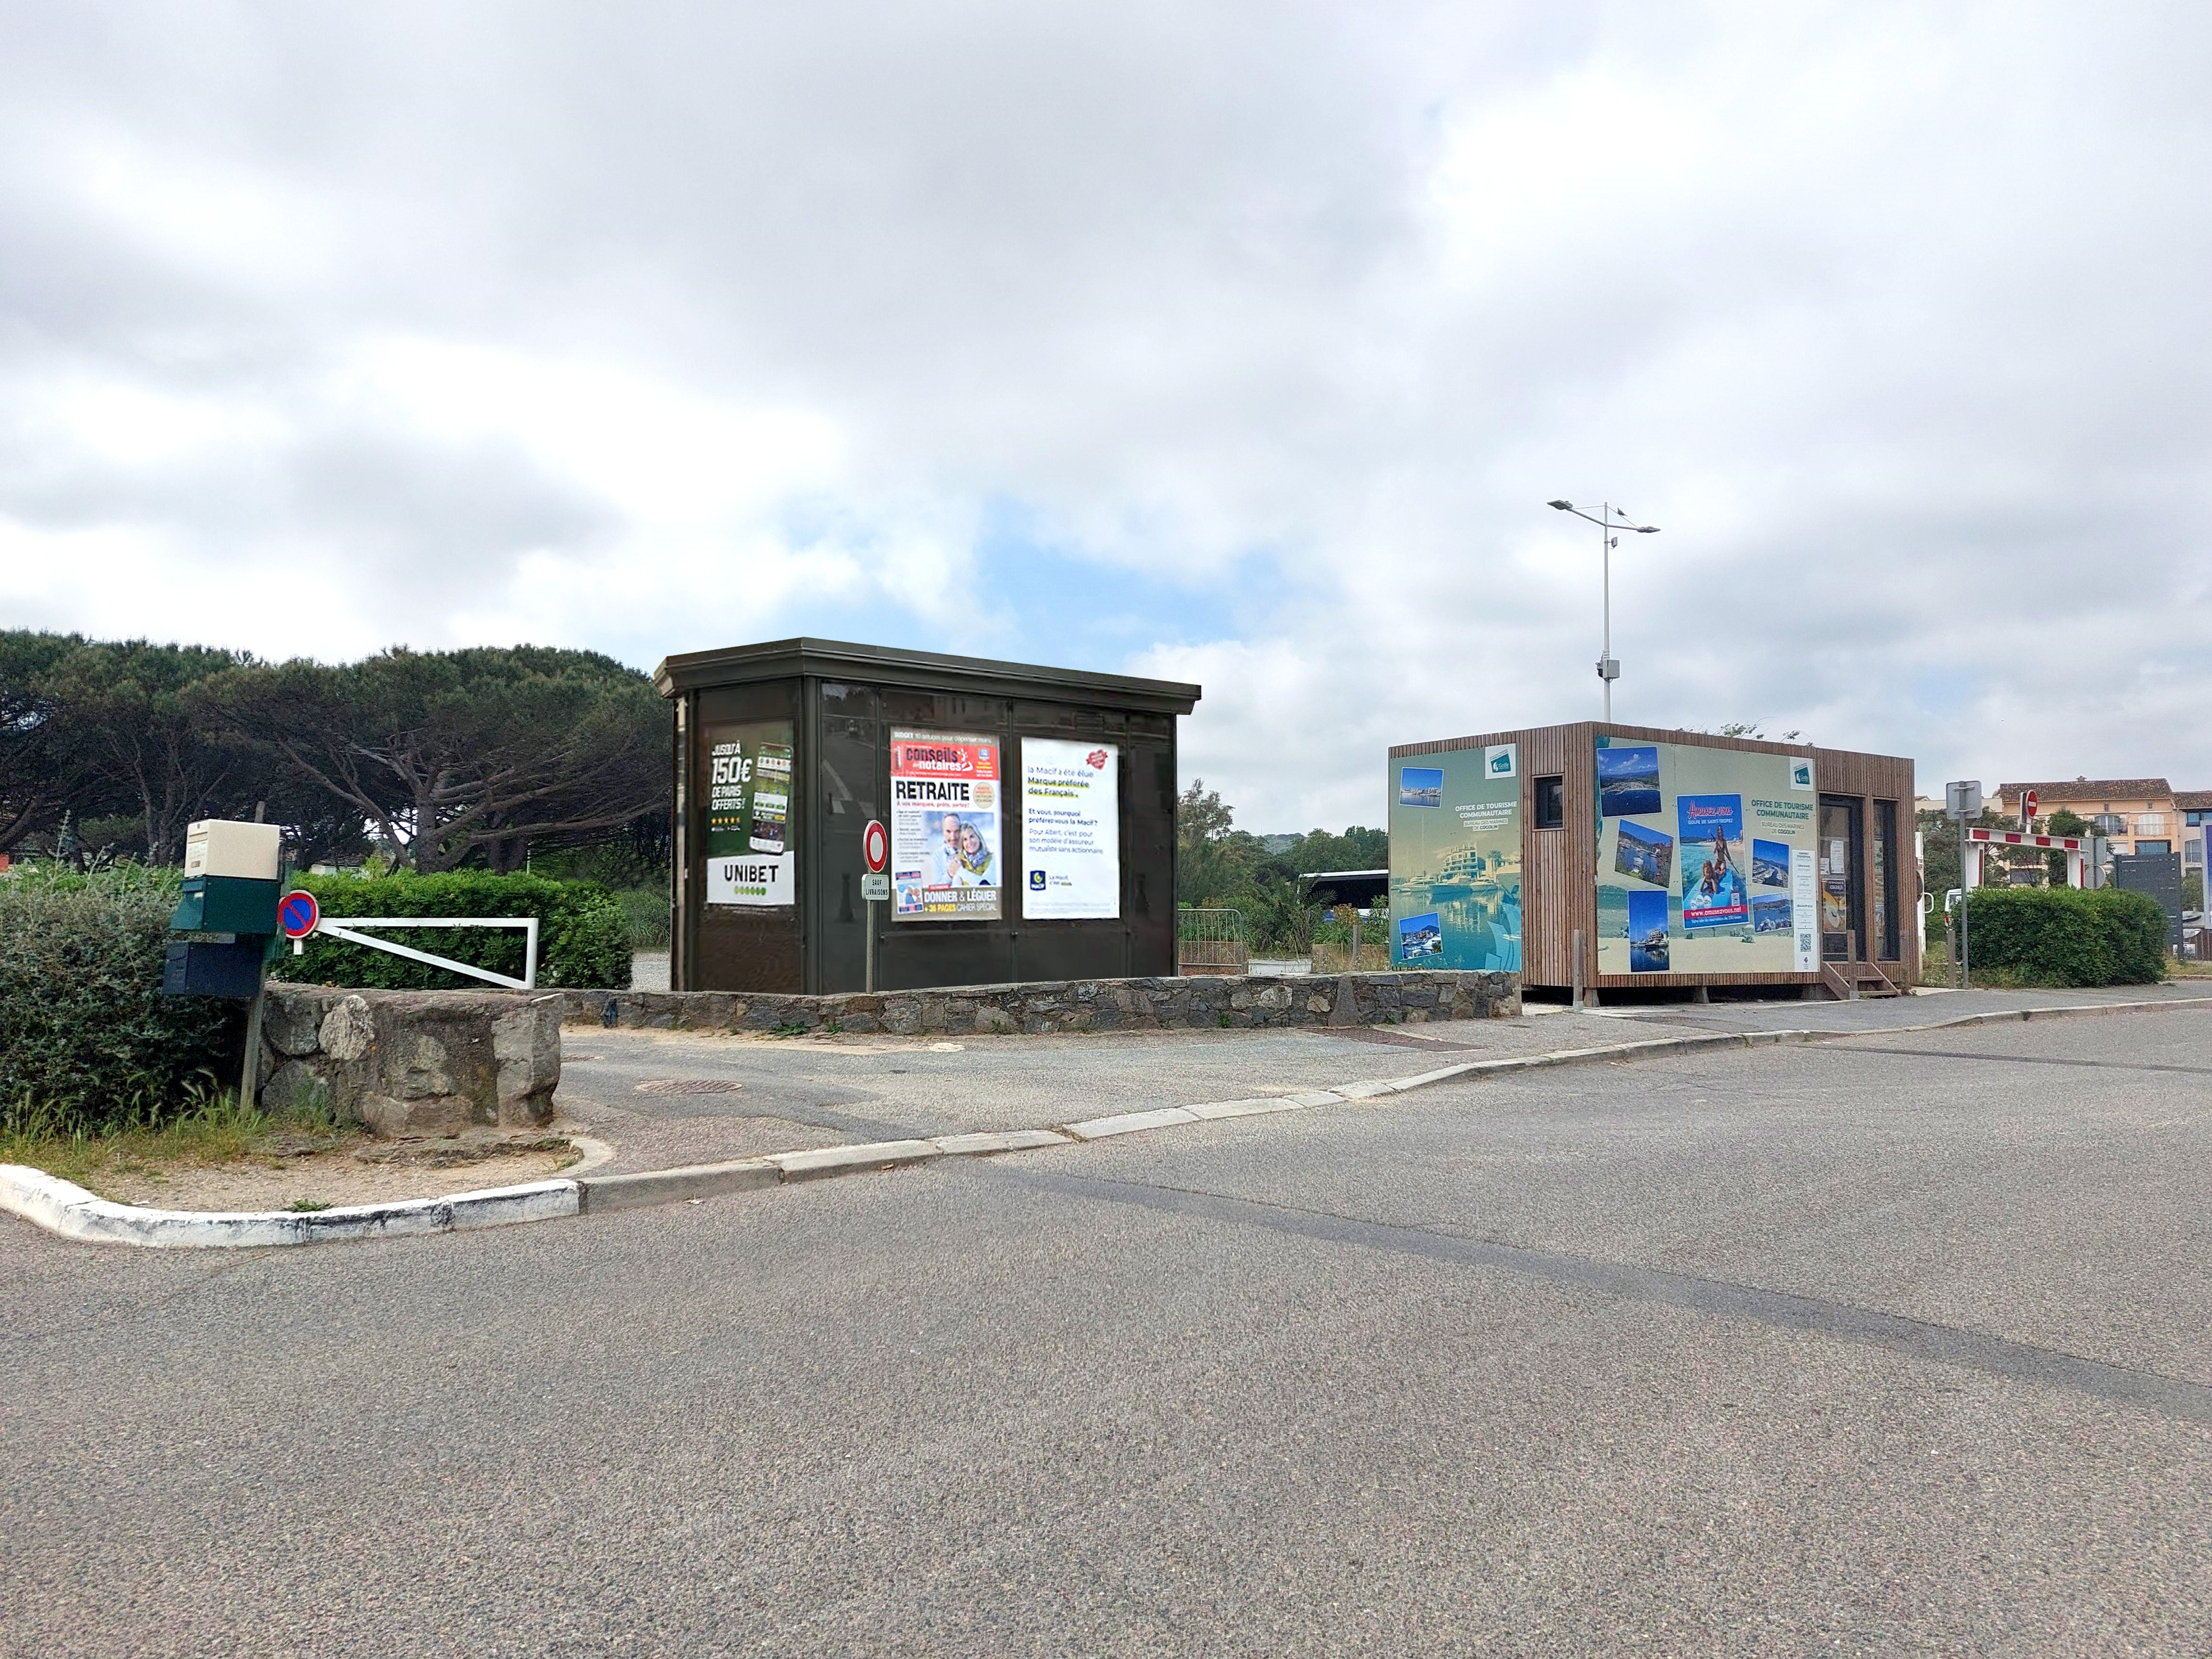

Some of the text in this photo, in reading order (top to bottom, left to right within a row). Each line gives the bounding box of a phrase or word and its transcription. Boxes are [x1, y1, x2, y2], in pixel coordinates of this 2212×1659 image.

[907, 747, 958, 763] conseils
[712, 756, 752, 784] 150€
[919, 759, 962, 771] notaires
[1078, 769, 1094, 778] élue
[1028, 777, 1089, 787] Marque préférée
[712, 785, 741, 797] DE PARIS
[896, 781, 969, 800] RETRAITE
[1486, 801, 1517, 809] TOURISME
[1751, 799, 1773, 808] OFFICE
[1783, 802, 1814, 811] TOURISME
[1460, 809, 1513, 818] COMMUNAUTAIRE
[1757, 809, 1809, 819] COMMUNAUTAIRE
[724, 865, 778, 882] UNIBET
[925, 892, 957, 902] DONNER
[967, 888, 996, 901] LÉGUER
[938, 904, 956, 912] PAGES
[1691, 906, 1741, 917] www.amusezvous.net
